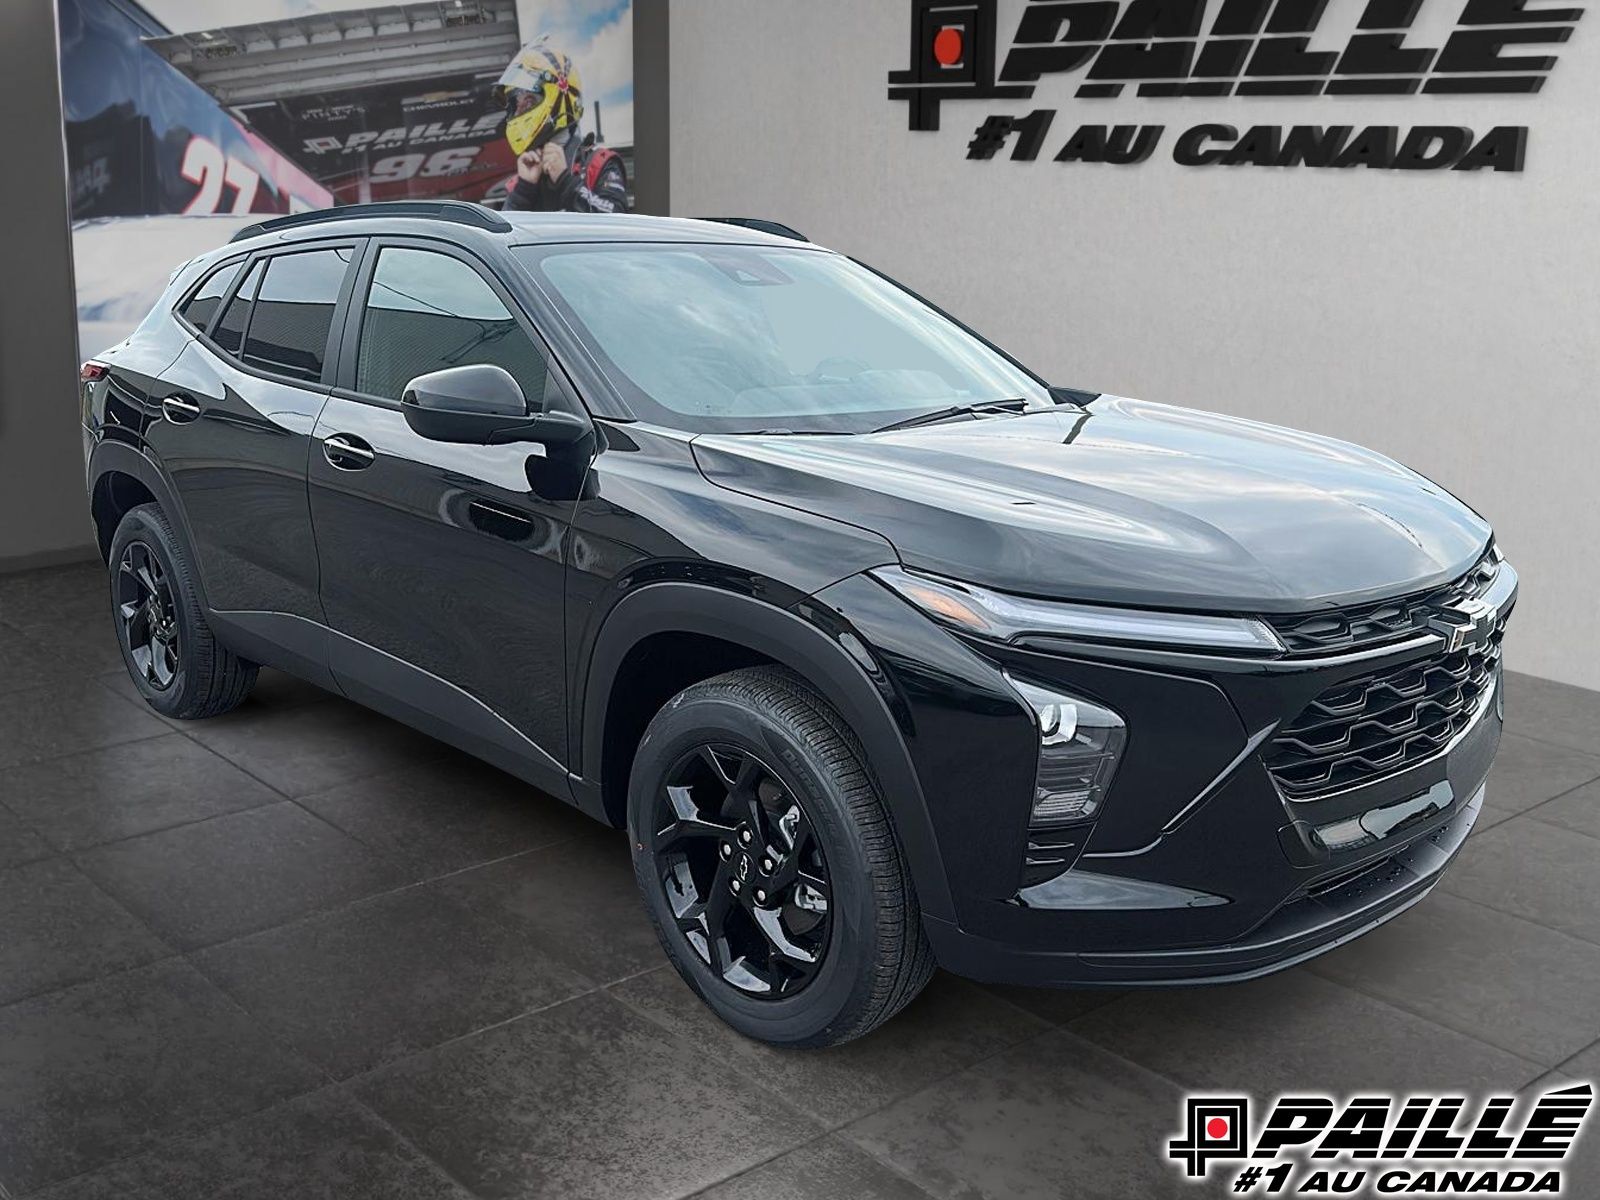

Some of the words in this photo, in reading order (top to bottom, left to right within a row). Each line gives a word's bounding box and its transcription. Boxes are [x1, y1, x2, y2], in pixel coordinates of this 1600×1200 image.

[372, 142, 400, 150] AU
[413, 129, 497, 145] CANADA
[966, 109, 1057, 161] #1
[1053, 124, 1165, 163] AU
[1172, 123, 1528, 172] CANADA
[181, 134, 260, 217] 27
[370, 146, 482, 184] 96
